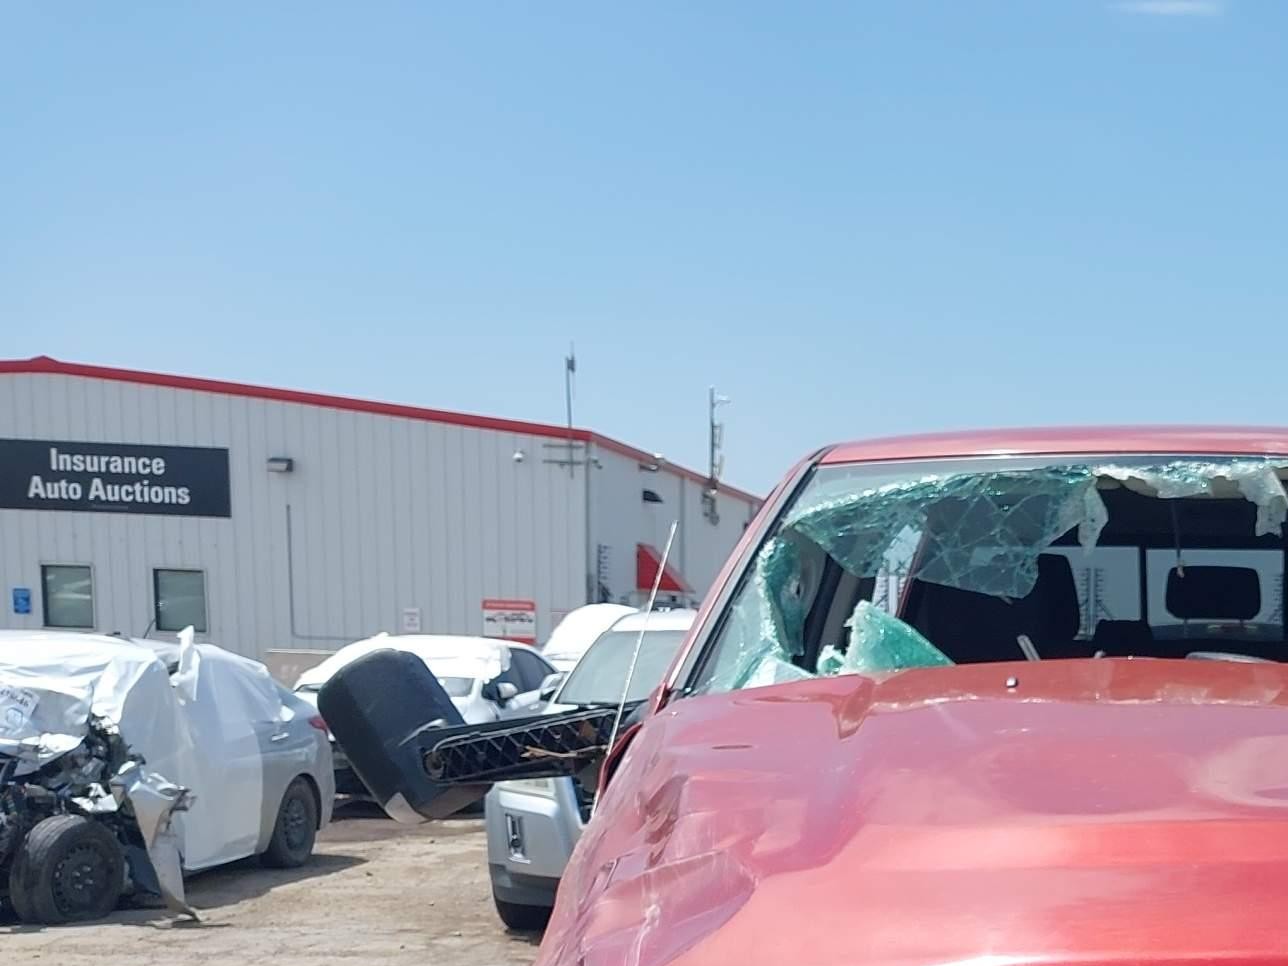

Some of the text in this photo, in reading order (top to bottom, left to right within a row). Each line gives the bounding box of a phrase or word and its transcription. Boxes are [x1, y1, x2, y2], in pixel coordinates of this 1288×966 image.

[50, 447, 165, 475] Insurance
[28, 475, 191, 504] Auto Auctions
